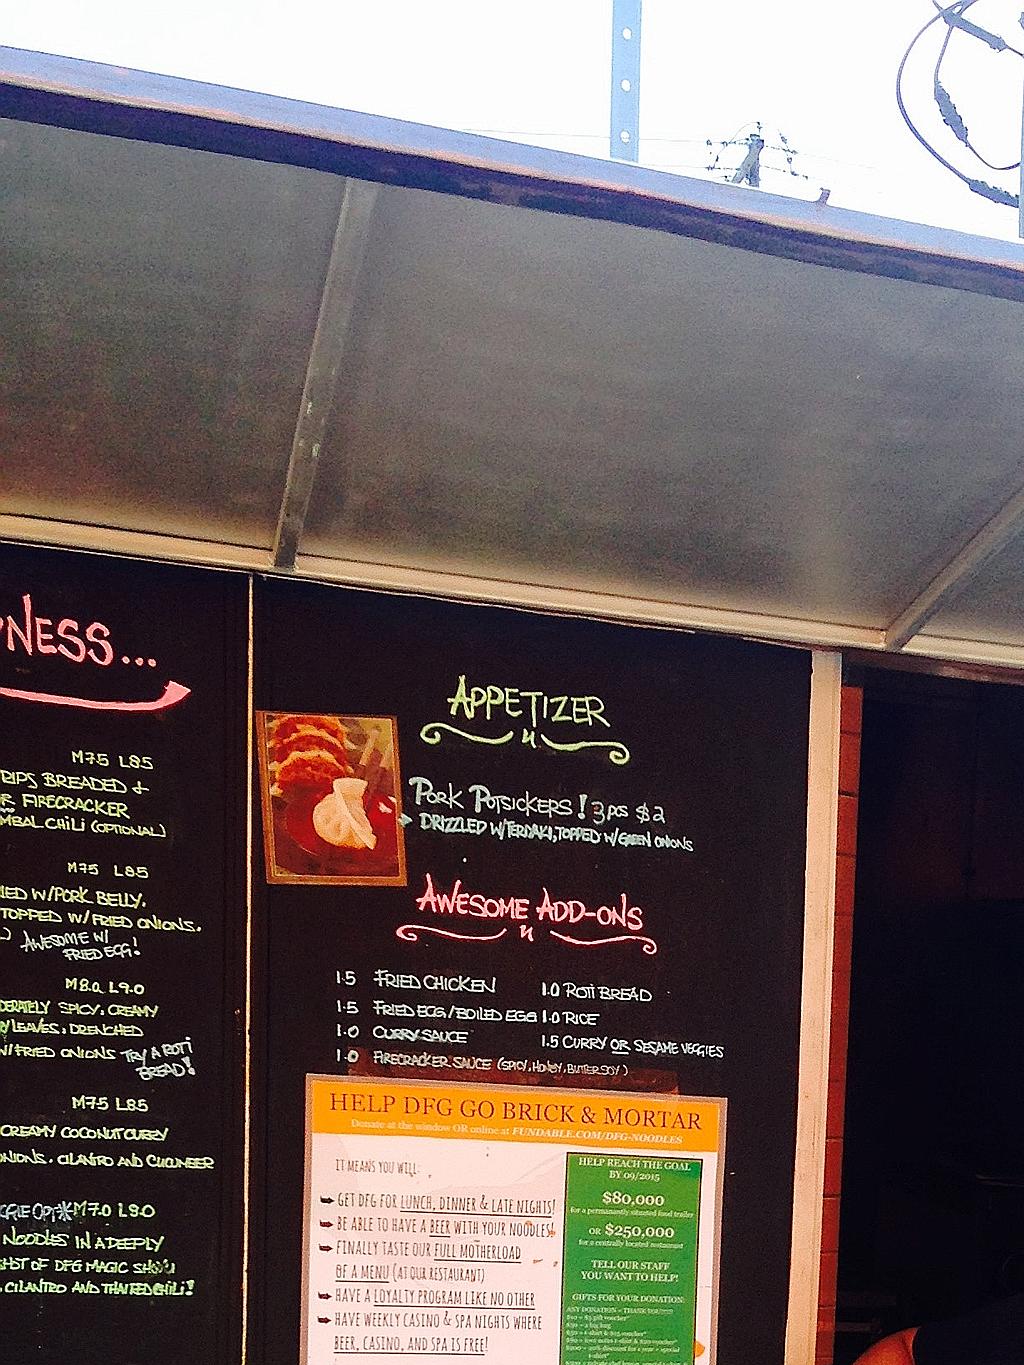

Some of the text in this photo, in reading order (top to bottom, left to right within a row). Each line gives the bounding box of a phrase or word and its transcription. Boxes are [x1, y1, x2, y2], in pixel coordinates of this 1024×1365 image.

[448, 675, 611, 727] APPETIZER
[41, 772, 127, 793] BREADED
[22, 793, 130, 819] FIRECRACKER
[419, 812, 487, 835] DRIZZLED
[417, 873, 643, 930] AWESOME ADD-ONS
[0, 908, 62, 922] TOPPED
[20, 930, 89, 952] AWESOME
[373, 969, 421, 989] FRIED
[423, 975, 496, 993] CHICKEN
[600, 986, 653, 1001] BREAD
[108, 1004, 159, 1017] CREAMY
[373, 1000, 415, 1017] FRIED
[506, 1010, 537, 1022] EGG
[563, 1012, 600, 1026] RICE
[69, 1023, 144, 1036] DRENCHED
[372, 1026, 420, 1042] CURRY
[421, 1030, 468, 1043] SAUCE
[60, 1046, 116, 1059] ONIONS
[562, 1036, 607, 1051] CURRY
[610, 1039, 631, 1052] OR
[634, 1039, 679, 1056] SESAME
[681, 1042, 724, 1058] VEGGIES
[373, 1050, 450, 1068] FIRECRACKER
[452, 1056, 492, 1070] SAUCE
[330, 1093, 702, 1130] HELP DFG GO BRICK & MORTAR
[0, 1125, 56, 1138] CREAMY
[61, 1127, 122, 1140] COCONUT
[351, 1119, 384, 1130] Donate
[452, 1125, 469, 1133] OR
[117, 1153, 143, 1167] AND
[348, 1160, 395, 1174] MEANS YOU
[579, 1157, 691, 1172] HELP REACH THE GOAL
[609, 1170, 660, 1182] BY 09/2015
[338, 1192, 355, 1207] GET
[358, 1193, 377, 1208] DFG
[380, 1194, 397, 1208] FOR
[400, 1195, 435, 1211] LUNCH,
[440, 1196, 476, 1212] DINNER
[480, 1194, 488, 1210] &
[491, 1199, 513, 1213] LATE
[517, 1199, 556, 1215] NIGHTS!
[337, 1217, 347, 1231] BE
[351, 1217, 373, 1232] ABLE
[377, 1218, 388, 1232] TO
[392, 1219, 417, 1234] HAVE
[420, 1220, 427, 1233] A
[429, 1220, 451, 1235] BEER
[454, 1221, 479, 1235] WITH
[482, 1222, 506, 1236] YOUR
[589, 1222, 675, 1239] OR $250,000
[3, 1226, 69, 1247] NOODLES
[75, 1231, 91, 1249] IN
[337, 1241, 521, 1260] FINALLY TASTE OUR FULL MOTHERLOAD
[31, 1258, 49, 1271] OF
[336, 1264, 348, 1278] OF
[361, 1265, 389, 1279] MENU
[410, 1266, 427, 1280] OUR
[429, 1267, 485, 1282] RESTAURANT)
[591, 1260, 670, 1271] TELL OUR STAFF
[580, 1271, 678, 1283] YOU WANT TO HELP!
[72, 1281, 100, 1294] AND
[335, 1288, 535, 1307] HAVE A LOYALTY PROGRAM LIKE NO OTHER
[572, 1294, 640, 1303] GIFTS FOR YOUR
[334, 1311, 542, 1330] HAVE WEEKLY CASINO & SPA NIGHTS WHERE
[334, 1336, 488, 1353] BEER, CASINO, AND SPA IS FREE!
